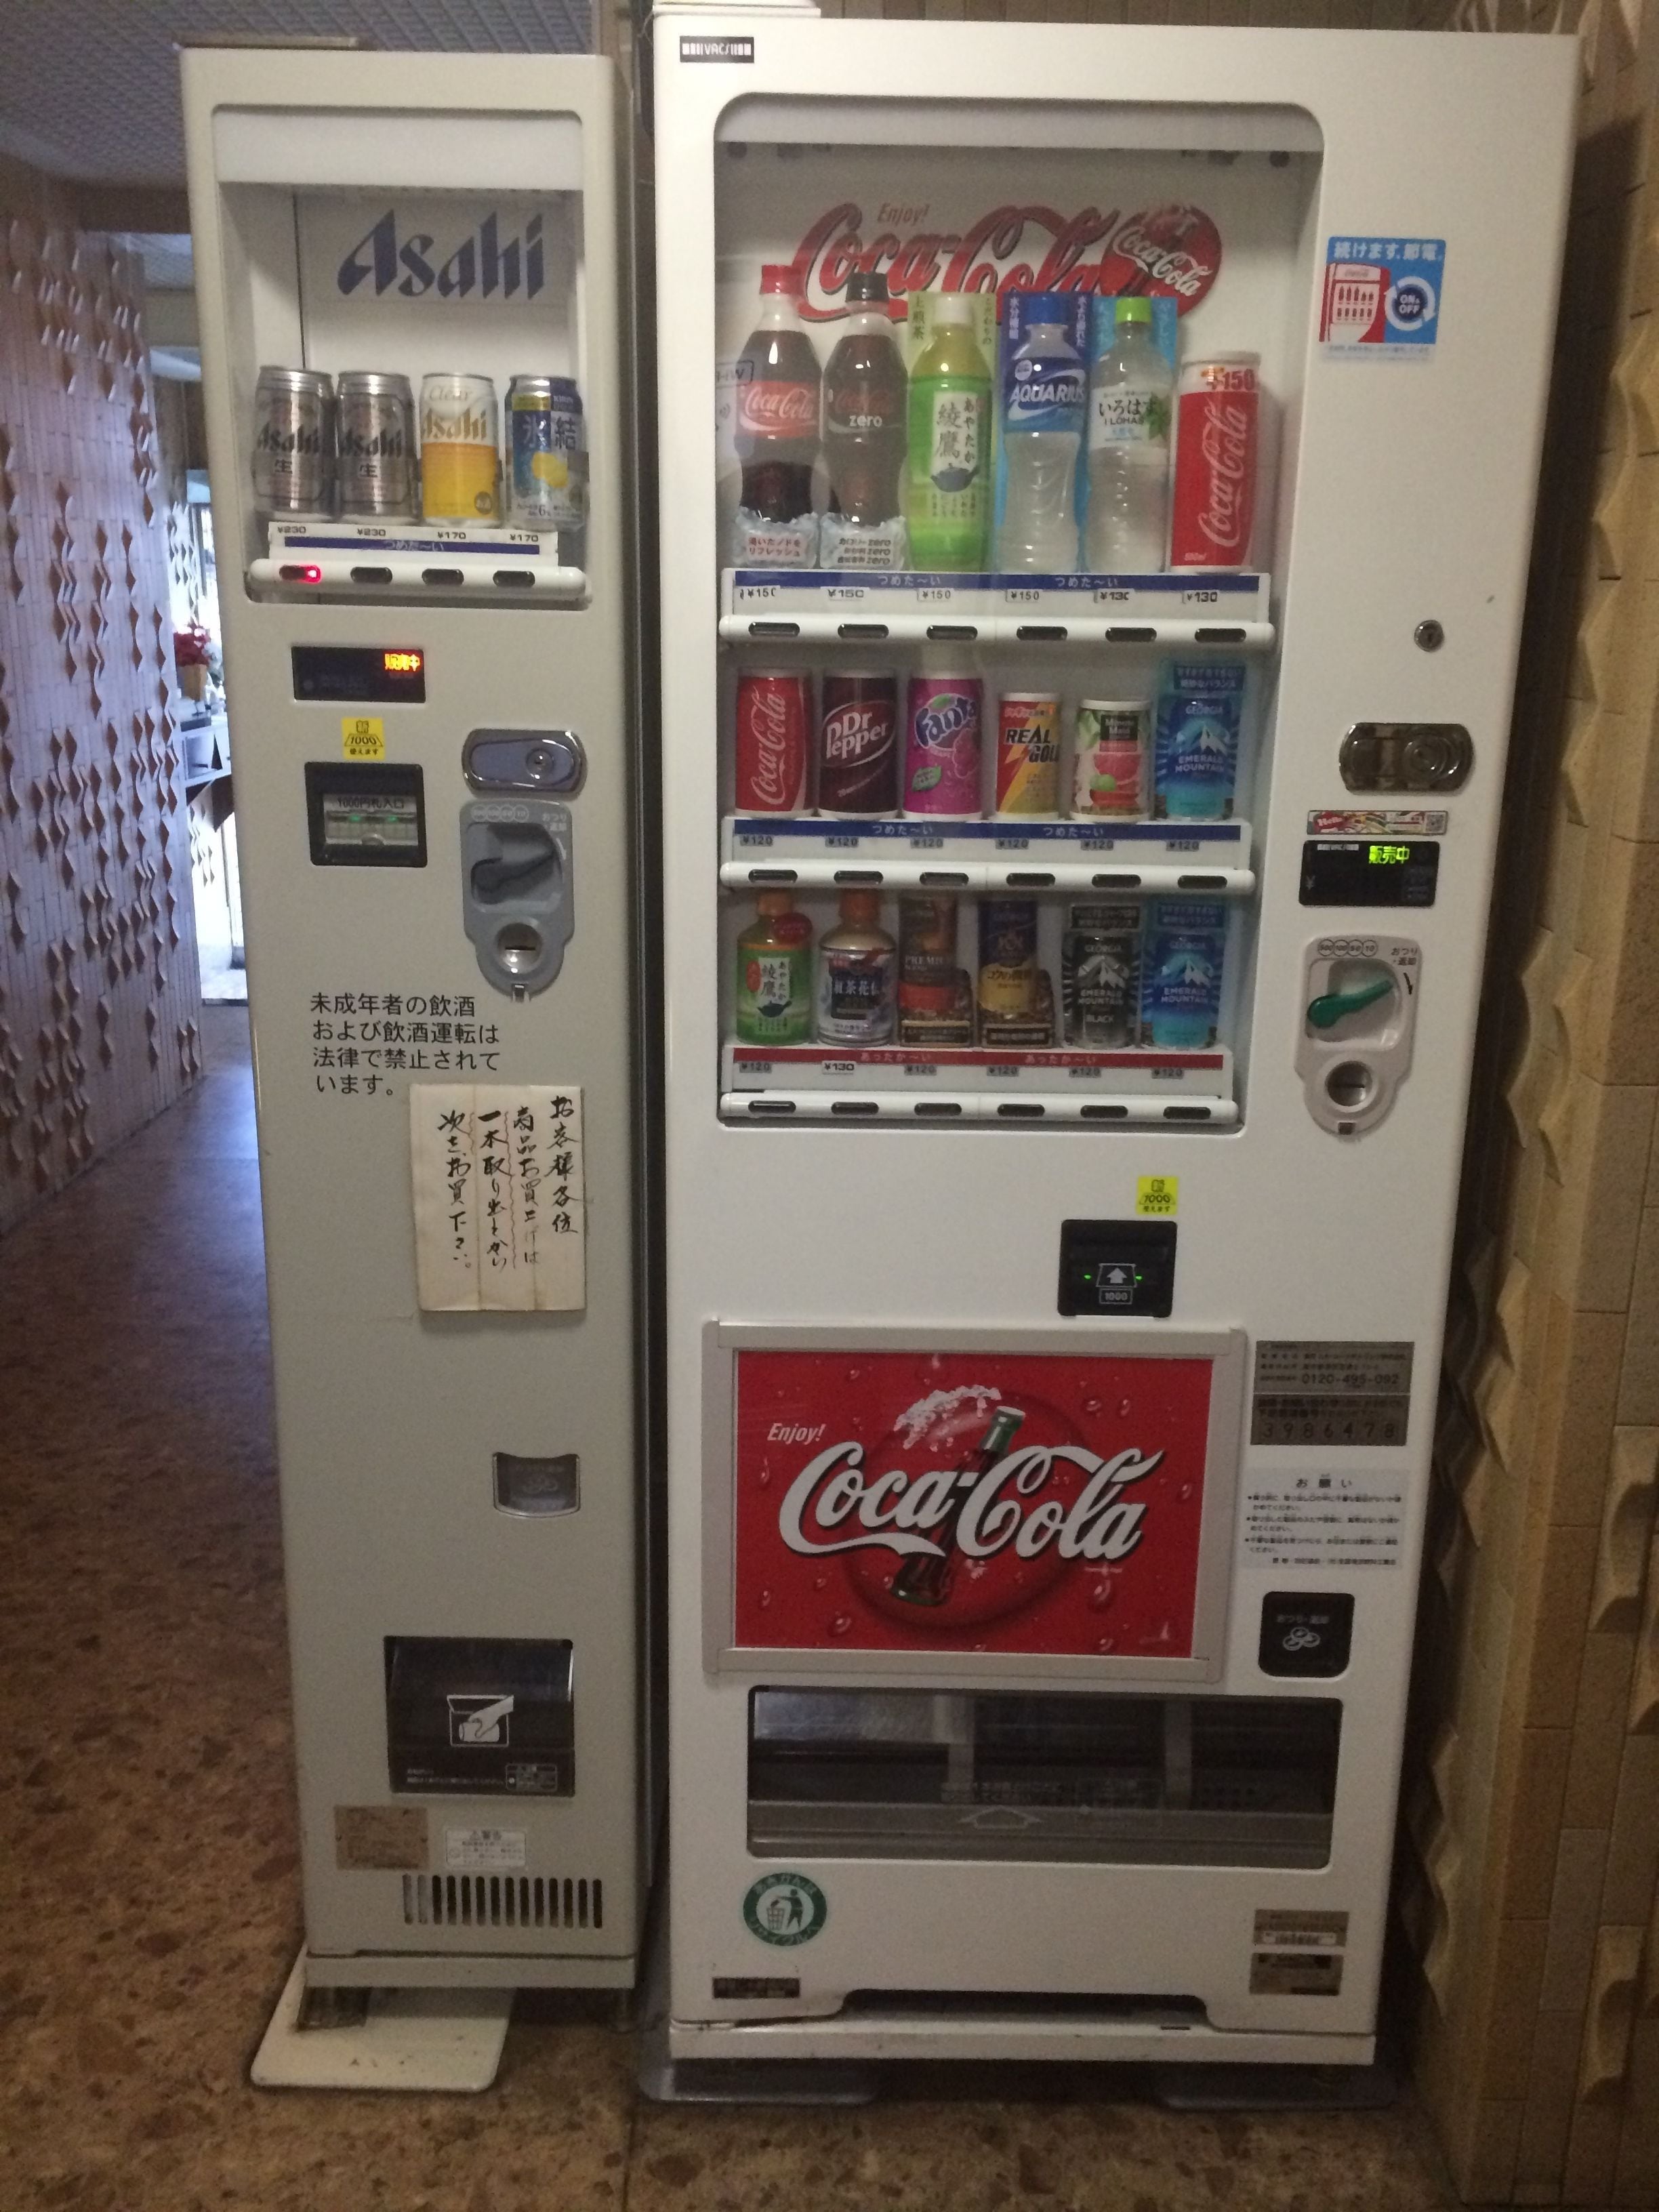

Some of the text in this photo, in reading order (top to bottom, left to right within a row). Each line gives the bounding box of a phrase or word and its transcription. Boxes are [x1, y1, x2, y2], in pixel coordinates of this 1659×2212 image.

[877, 203, 930, 227] Enjoy!
[337, 209, 544, 300] Asahi
[792, 201, 1121, 324] Coca-Cola
[1113, 225, 1214, 296] Coca-Cola
[1399, 304, 1420, 315] OFF
[429, 384, 472, 403] Clear
[744, 386, 815, 419] Coca-Cola
[1009, 382, 1086, 404] AQUARIUS
[1099, 397, 1157, 416] いろはす
[418, 408, 488, 442] Asahi
[849, 413, 883, 428] zero
[256, 422, 320, 457] Asahi
[522, 416, 577, 450] 氷結
[963, 397, 976, 464] あやたか
[274, 460, 293, 474] 生
[359, 464, 377, 478] 生
[1198, 401, 1249, 548] Coca-Cola
[356, 528, 386, 537] ¥230
[436, 531, 467, 541] ¥170
[509, 533, 539, 543] ¥170
[748, 547, 801, 558] リフレッシュ
[827, 589, 864, 598] ¥150
[922, 590, 951, 600] ¥150
[1010, 590, 1040, 601] ¥150
[1186, 592, 1218, 602] ¥130
[1185, 705, 1223, 715] GEORGIA
[842, 711, 873, 735] Dr
[913, 696, 977, 748] Fanta
[350, 736, 377, 746] 1000
[826, 720, 890, 760] Pepper
[1005, 724, 1051, 744] REAL
[750, 684, 786, 805] Coca-Cola
[1174, 762, 1225, 773] MOUNTAIN
[1178, 754, 1223, 764] EMERALD
[336, 796, 405, 809] 1000円札入口
[1368, 844, 1410, 864] 販売中
[1391, 947, 1418, 956] おつり
[1080, 989, 1123, 999] EMERALD
[1160, 995, 1209, 1005] MOUNTAIN
[1164, 987, 1207, 997] EMERALD
[310, 993, 476, 1016] 未成年者の飲酒
[1085, 1014, 1115, 1024] BLACK
[312, 1021, 500, 1045] および飲酒運転は
[312, 1046, 501, 1071] 法律で禁止されて
[823, 1062, 855, 1071] ¥130
[316, 1074, 395, 1097] います。
[545, 1094, 581, 1235] お客様各位
[1144, 1194, 1171, 1204] 1000
[1105, 1292, 1128, 1301] 1000
[766, 1422, 825, 1446] Enjoy!
[779, 1440, 1166, 1561] Coca-Cola
